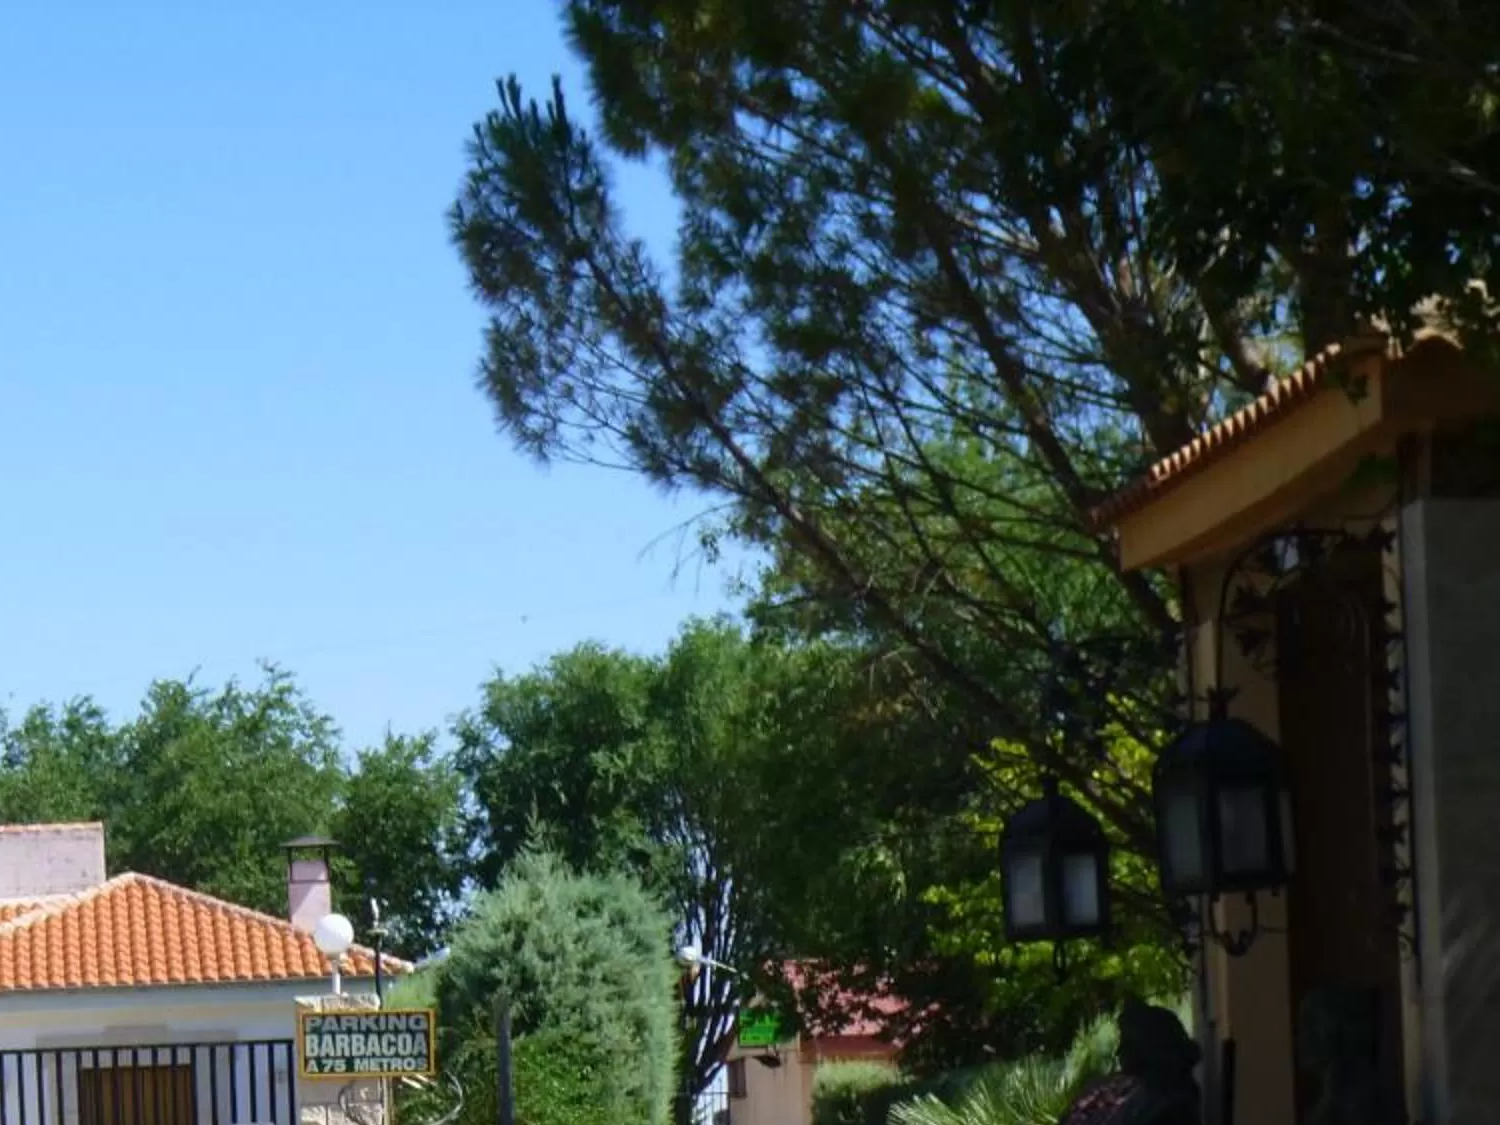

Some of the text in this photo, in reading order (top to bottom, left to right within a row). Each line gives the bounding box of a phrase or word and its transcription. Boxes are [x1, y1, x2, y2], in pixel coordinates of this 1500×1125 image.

[306, 1014, 428, 1032] PARKING
[306, 1034, 428, 1057] BARBACOA
[307, 1057, 428, 1073] A 75 METROS
